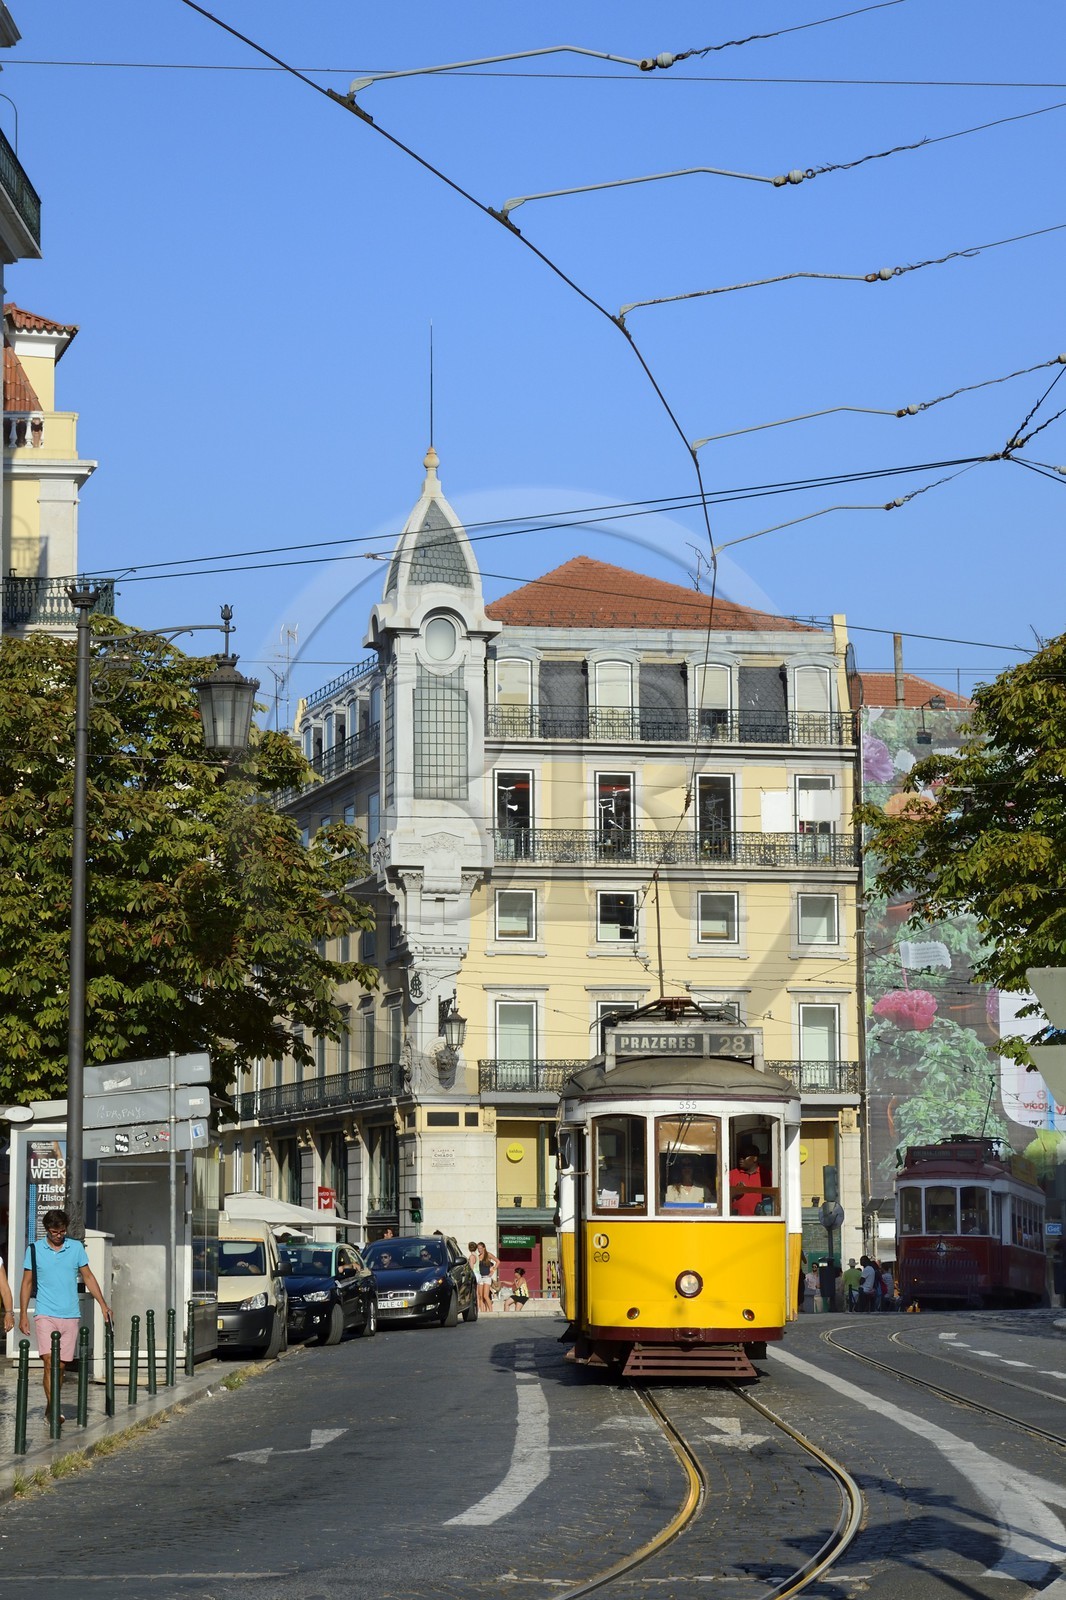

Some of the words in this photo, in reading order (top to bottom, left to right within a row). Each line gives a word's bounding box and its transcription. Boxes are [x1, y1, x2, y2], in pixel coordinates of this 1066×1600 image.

[621, 1037, 695, 1049] PRAZERES
[719, 1036, 746, 1053] 28
[679, 1101, 697, 1110] 555
[31, 1168, 66, 1178] WEEK
